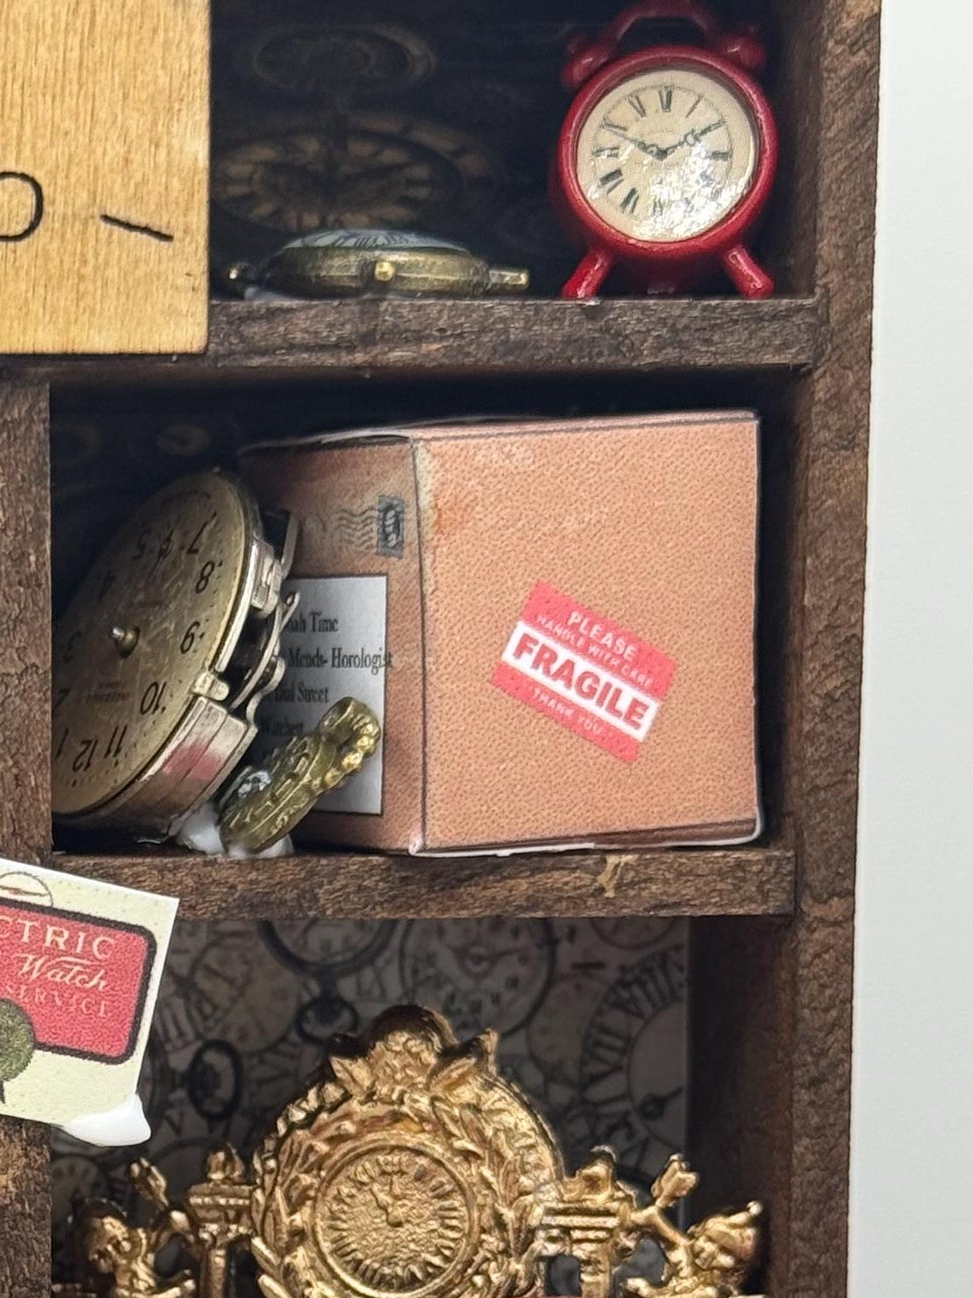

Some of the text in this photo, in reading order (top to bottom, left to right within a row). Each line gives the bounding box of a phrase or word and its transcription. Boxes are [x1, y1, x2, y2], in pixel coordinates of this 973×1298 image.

[567, 610, 638, 663] PLEASE
[512, 632, 651, 731] FRAGILE
[530, 685, 576, 718] THANK
[15, 952, 108, 993] Watch
